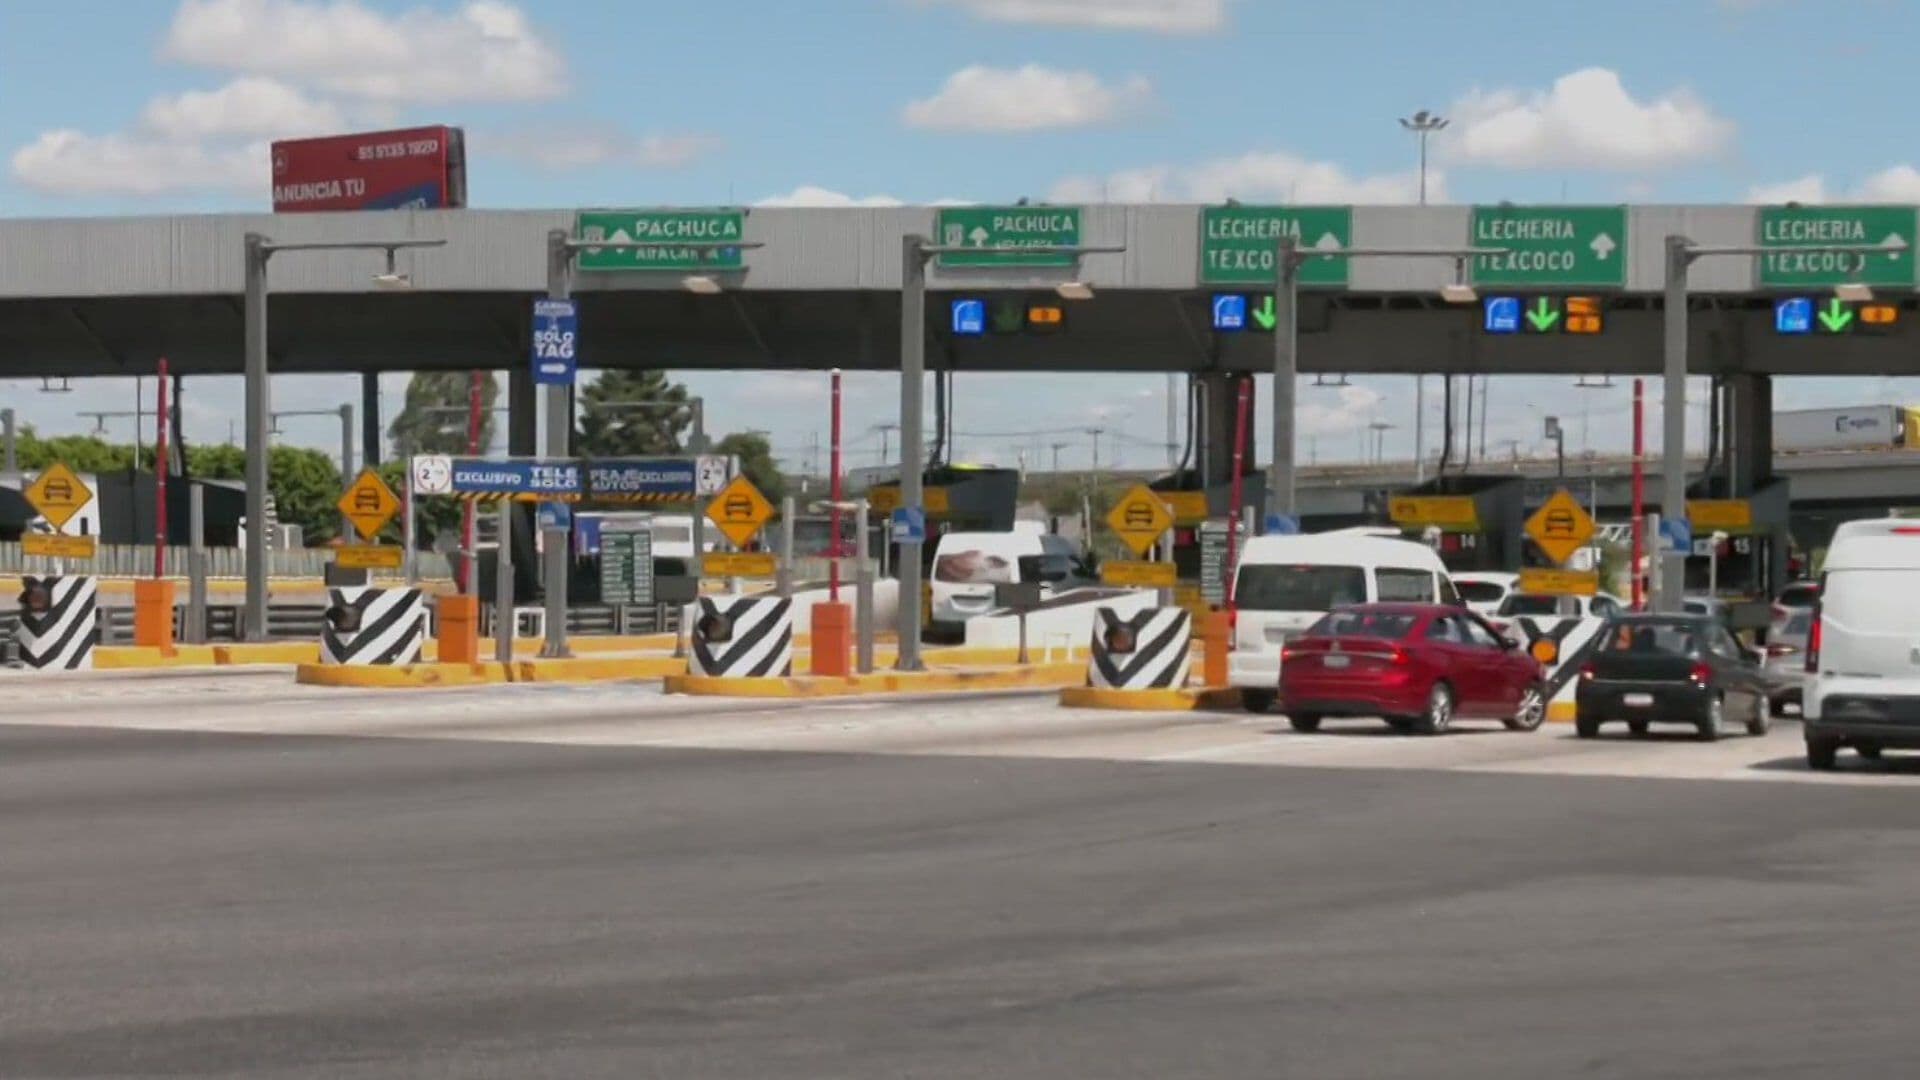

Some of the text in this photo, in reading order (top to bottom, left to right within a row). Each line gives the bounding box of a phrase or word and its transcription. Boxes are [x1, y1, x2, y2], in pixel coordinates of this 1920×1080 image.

[359, 145, 374, 160] 55
[273, 178, 365, 203] ANUNCIA TU
[635, 219, 737, 237] PACHUCA
[993, 215, 1073, 232] PACHUCA
[1208, 219, 1301, 240] LECHERIA
[1478, 220, 1575, 239] LECHERIA
[1765, 221, 1865, 240] LECHERIA
[1208, 250, 1276, 270] TEXCO
[1479, 251, 1575, 271] TEXCOCO
[534, 330, 574, 343] SOLO
[534, 343, 574, 359] TAG
[455, 471, 521, 485] EXCLUSIVO
[530, 466, 577, 477] TELE
[530, 477, 577, 488] SOLO
